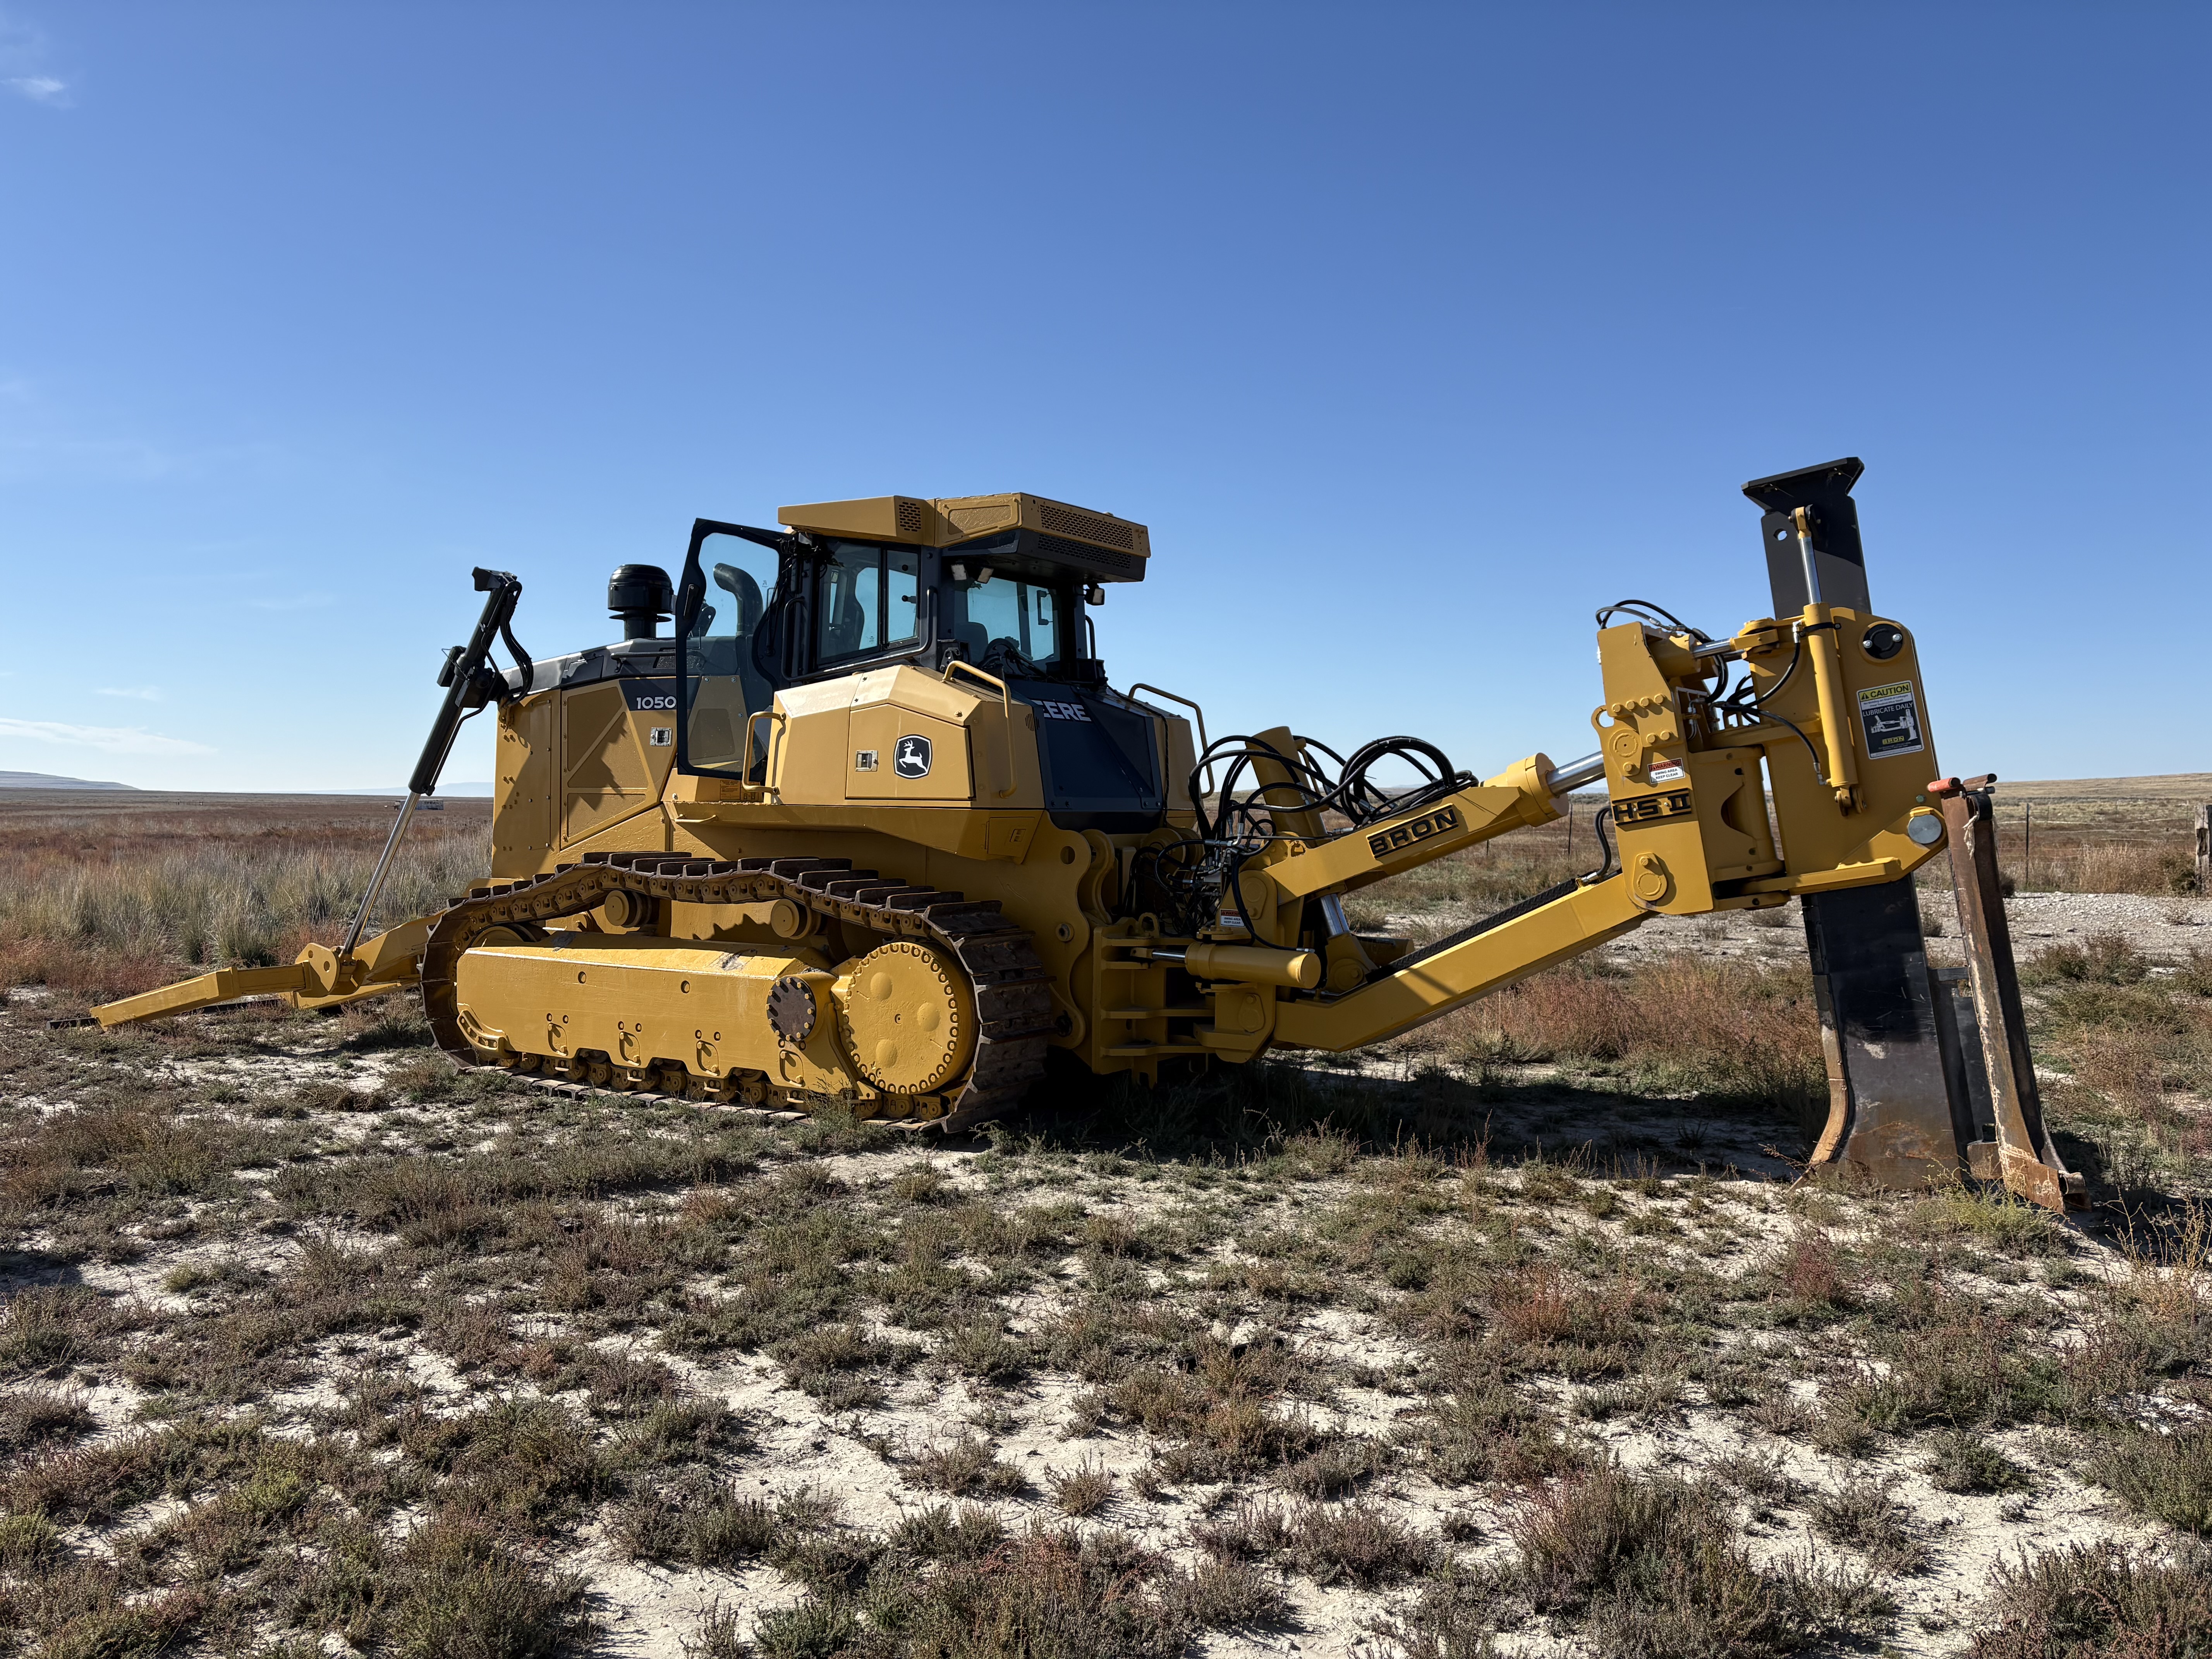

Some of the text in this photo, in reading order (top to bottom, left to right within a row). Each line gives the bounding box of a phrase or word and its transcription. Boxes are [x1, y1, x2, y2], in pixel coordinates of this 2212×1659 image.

[1870, 684, 1909, 697] CAUTION
[636, 696, 677, 709] 1050
[1863, 706, 1895, 716] LUBRICATE
[1896, 702, 1913, 710] DAILY
[1031, 700, 1092, 721] ERE
[1655, 760, 1680, 769] WARNING
[1613, 799, 1659, 821] HS
[1369, 809, 1457, 855] BRON
